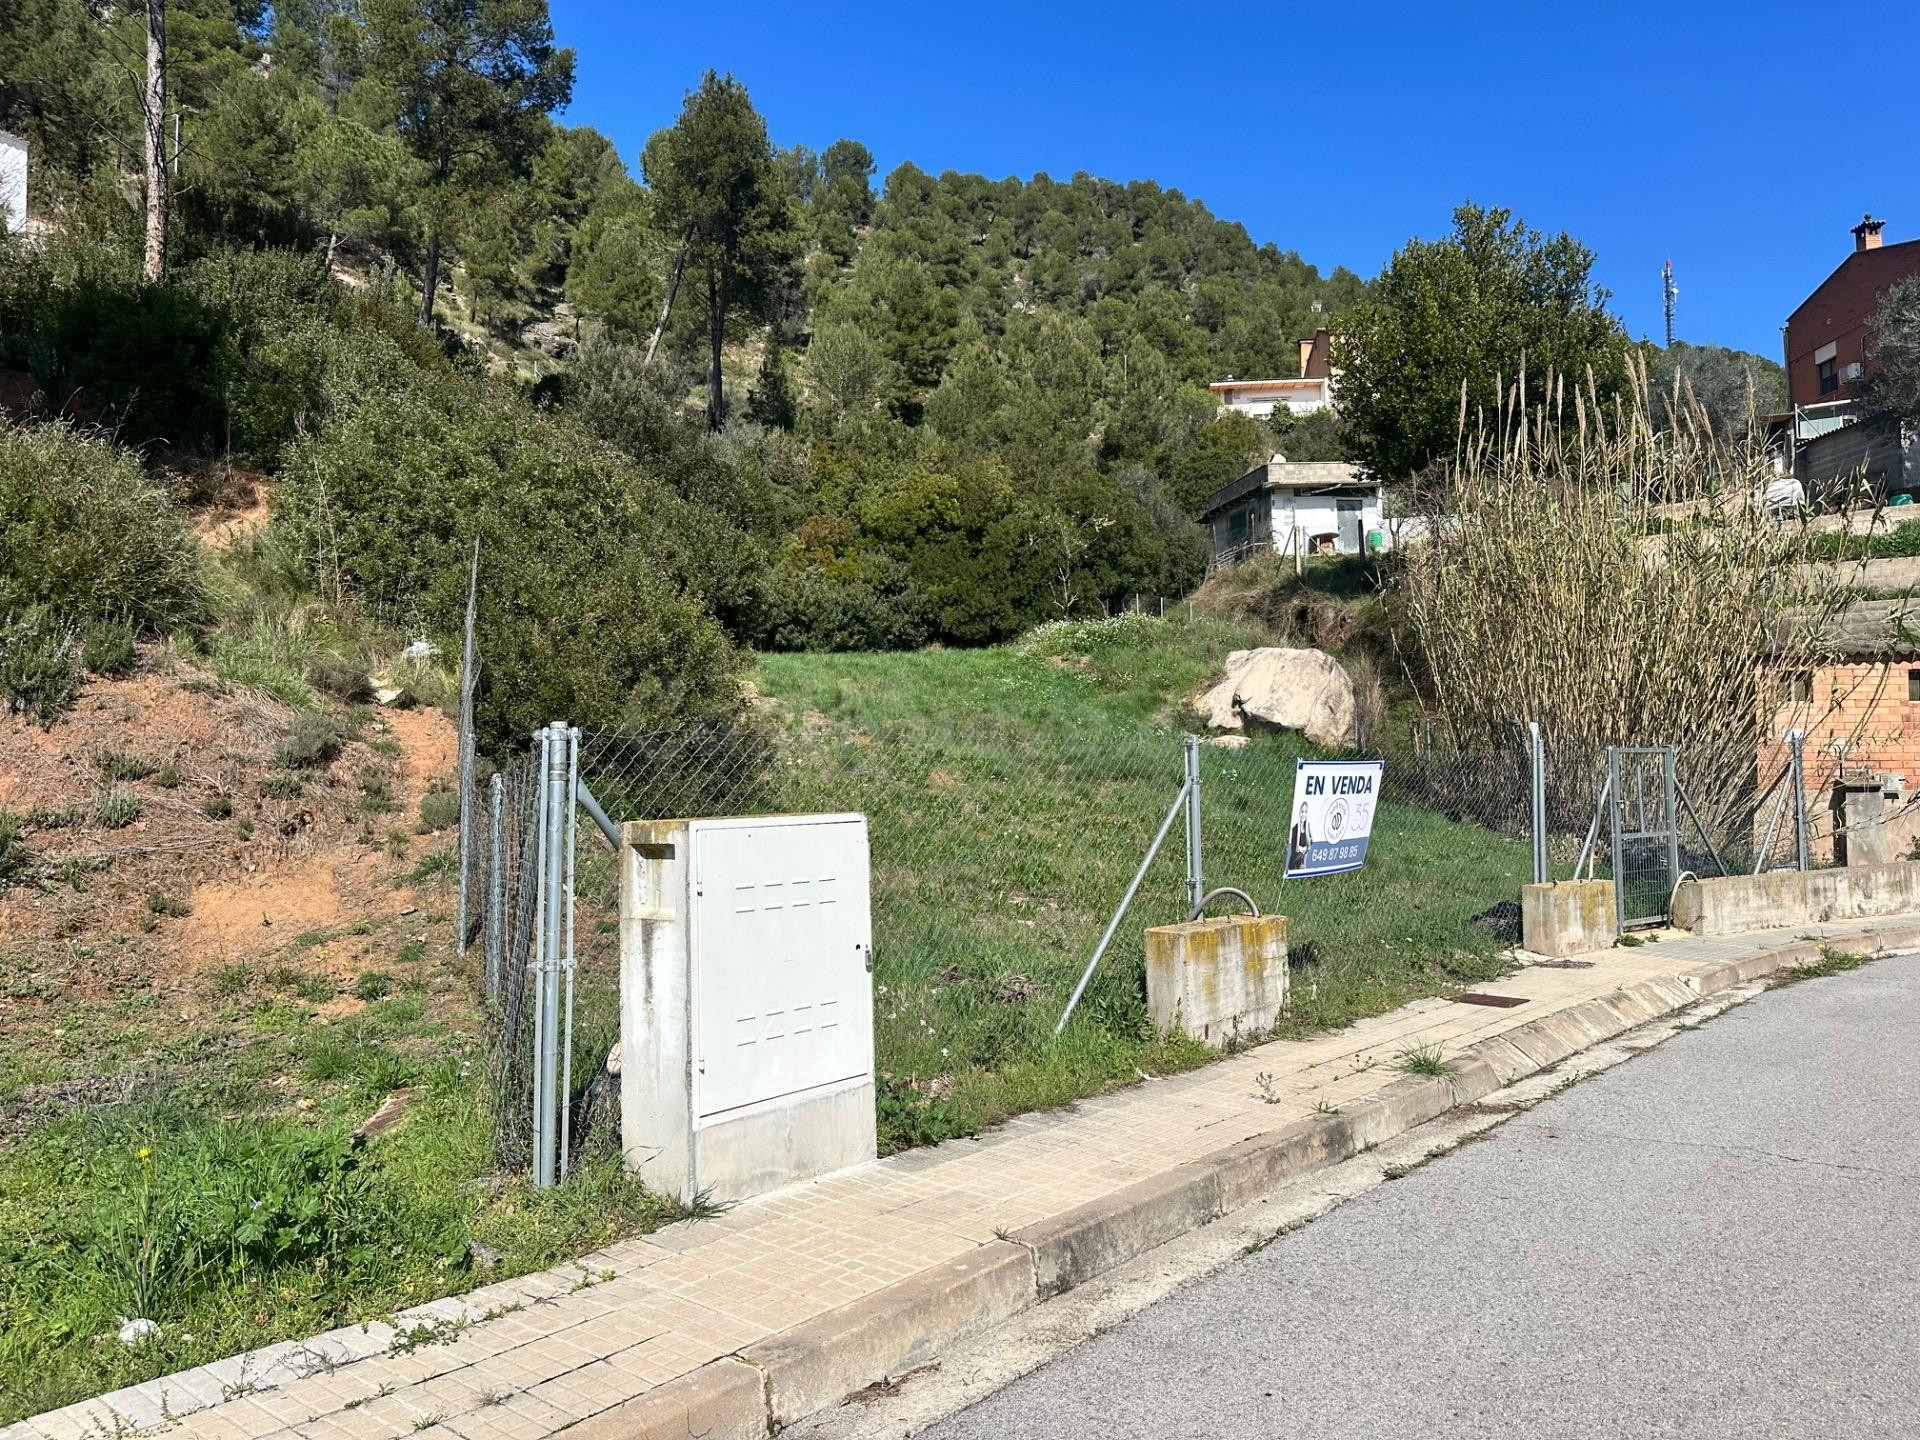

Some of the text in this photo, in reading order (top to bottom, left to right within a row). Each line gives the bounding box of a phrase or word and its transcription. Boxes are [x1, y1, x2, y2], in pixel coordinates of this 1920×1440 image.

[1306, 776, 1372, 795] EN VENDA
[1312, 849, 1328, 862] 649
[1328, 848, 1339, 860] 87
[1339, 846, 1349, 859] 98
